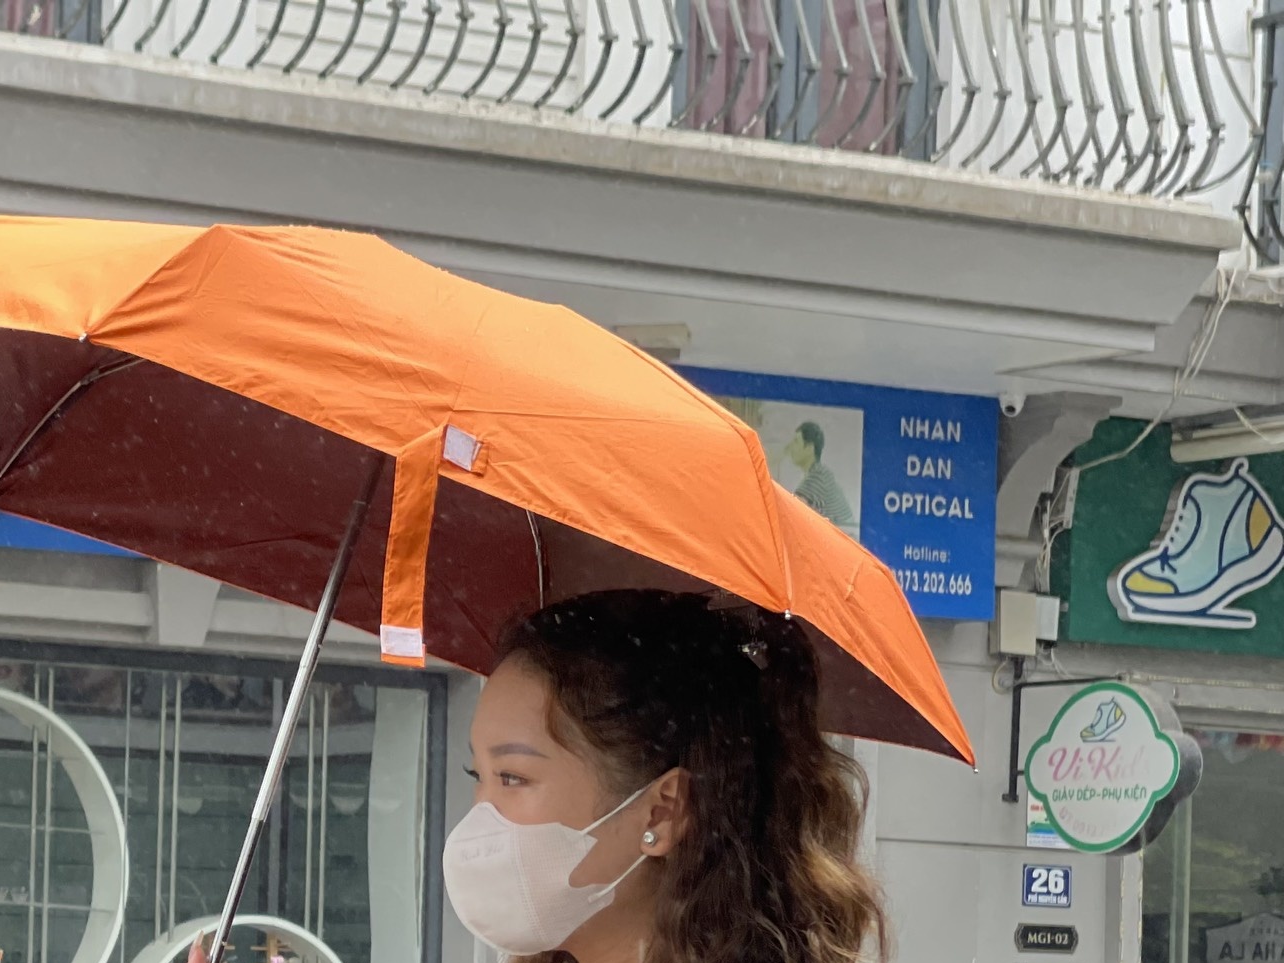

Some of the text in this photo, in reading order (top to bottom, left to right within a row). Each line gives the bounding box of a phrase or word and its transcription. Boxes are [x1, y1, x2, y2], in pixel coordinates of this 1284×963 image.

[900, 417, 962, 443] NHAN
[906, 455, 952, 480] DAN
[884, 491, 973, 519] OPTICAL
[904, 545, 951, 563] Hotline:
[892, 568, 972, 596] 373.202.666
[1031, 868, 1064, 894] 26
